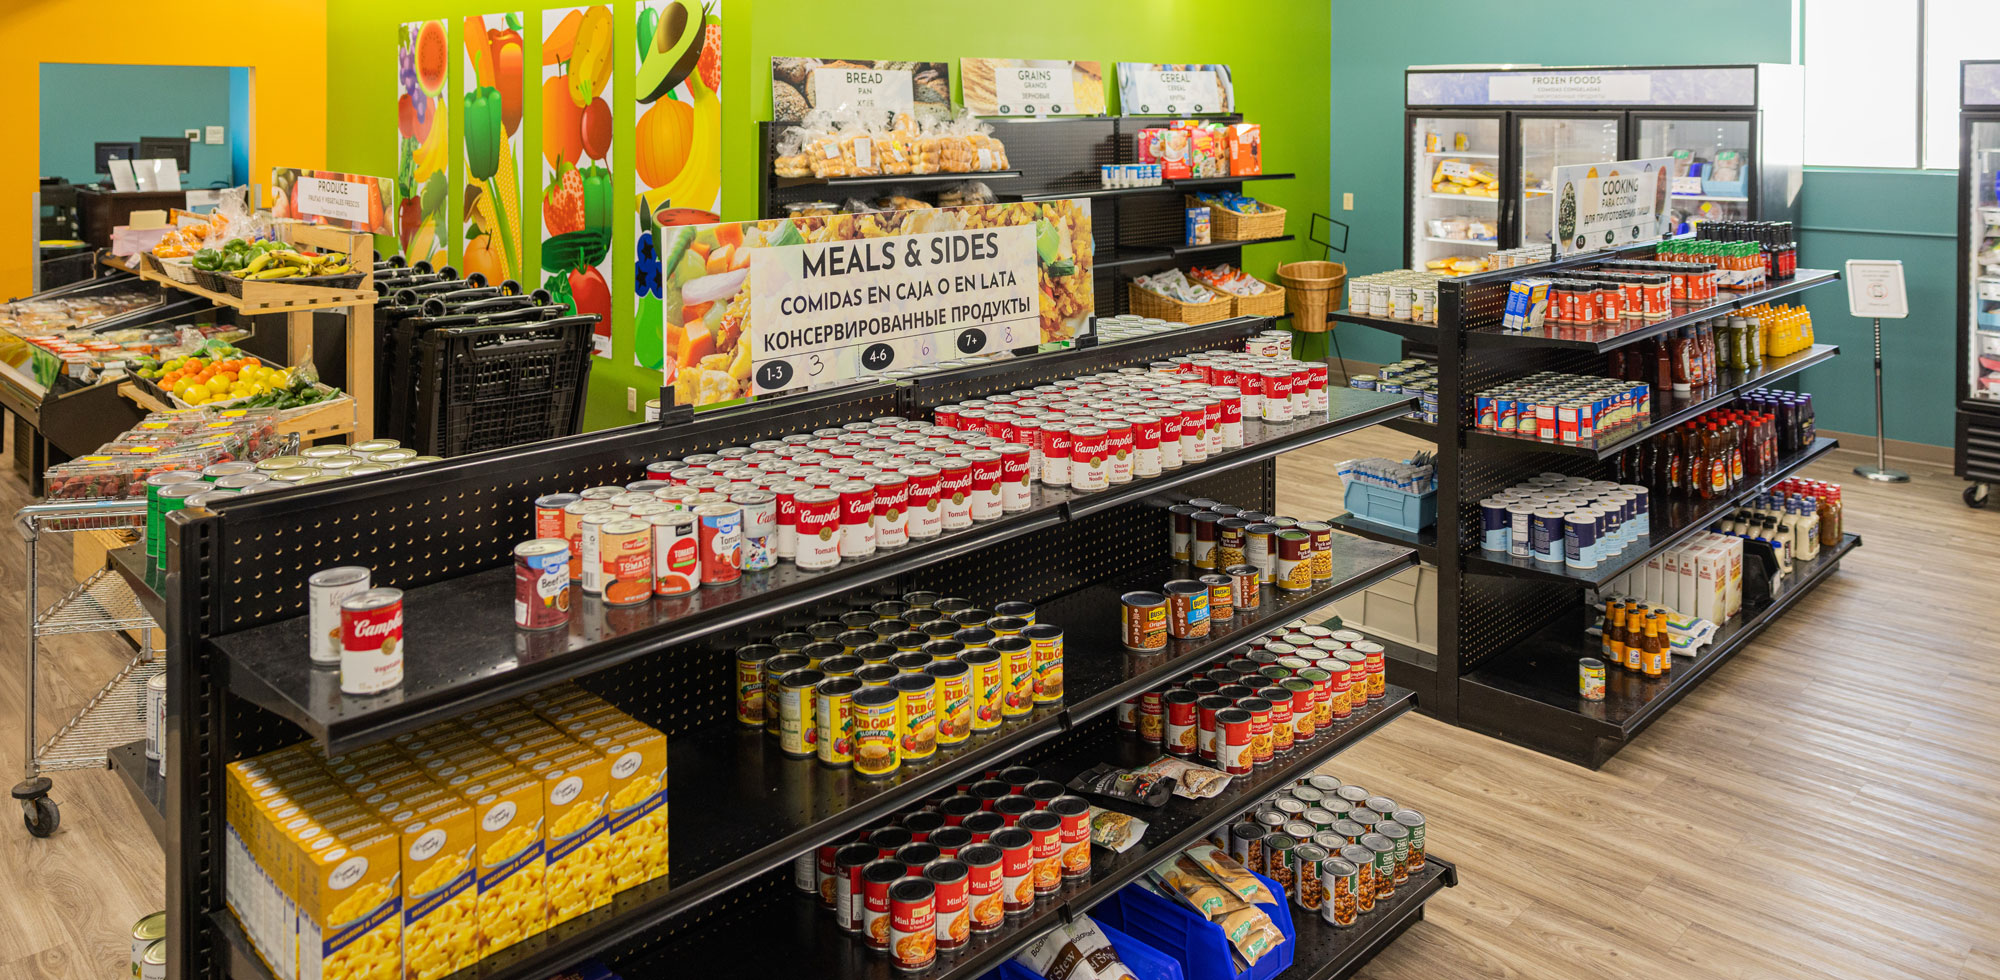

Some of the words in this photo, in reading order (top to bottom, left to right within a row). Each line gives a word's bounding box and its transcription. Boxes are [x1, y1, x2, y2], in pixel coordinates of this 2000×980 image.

[846, 72, 882, 84] BREAD
[1018, 70, 1051, 80] GRAINS
[1160, 74, 1190, 82] CEREAL
[1532, 76, 1566, 85] FROZEN
[1569, 76, 1602, 84] FOODS
[318, 180, 348, 195] PRODUCE
[1602, 178, 1638, 196] COOKING
[1602, 198, 1614, 208] PARA
[802, 240, 896, 279] MEALS
[904, 239, 922, 267] &
[931, 232, 999, 264] SIDES
[780, 288, 862, 316] COMIDAS
[868, 286, 892, 306] EN
[896, 280, 934, 302] CAJA
[938, 278, 950, 295] O
[956, 274, 977, 294] EN
[981, 270, 1016, 290] LATA
[764, 311, 947, 353] КОНСЕРВИРОВАННЫЕ
[951, 296, 1031, 324] ПРОДУКТЫ
[966, 334, 979, 347] 7+
[1004, 326, 1014, 344] 8
[920, 341, 931, 357] 6
[869, 348, 888, 363] 4-6
[808, 353, 825, 377] 3
[766, 366, 784, 382] 1-3
[882, 527, 903, 536] Tomato
[815, 546, 836, 555] Tomato
[620, 558, 650, 572] TOMATO
[541, 578, 559, 589] Beef
[1215, 588, 1230, 596] BUSH'S
[907, 704, 926, 716] RED
[870, 714, 896, 730] GOLD
[1013, 862, 1027, 870] Mini
[869, 896, 884, 906] Mini
[946, 898, 962, 906] Mini
[894, 915, 909, 925] Mini
[910, 914, 926, 925] Beef
[1054, 950, 1076, 978] Stew
